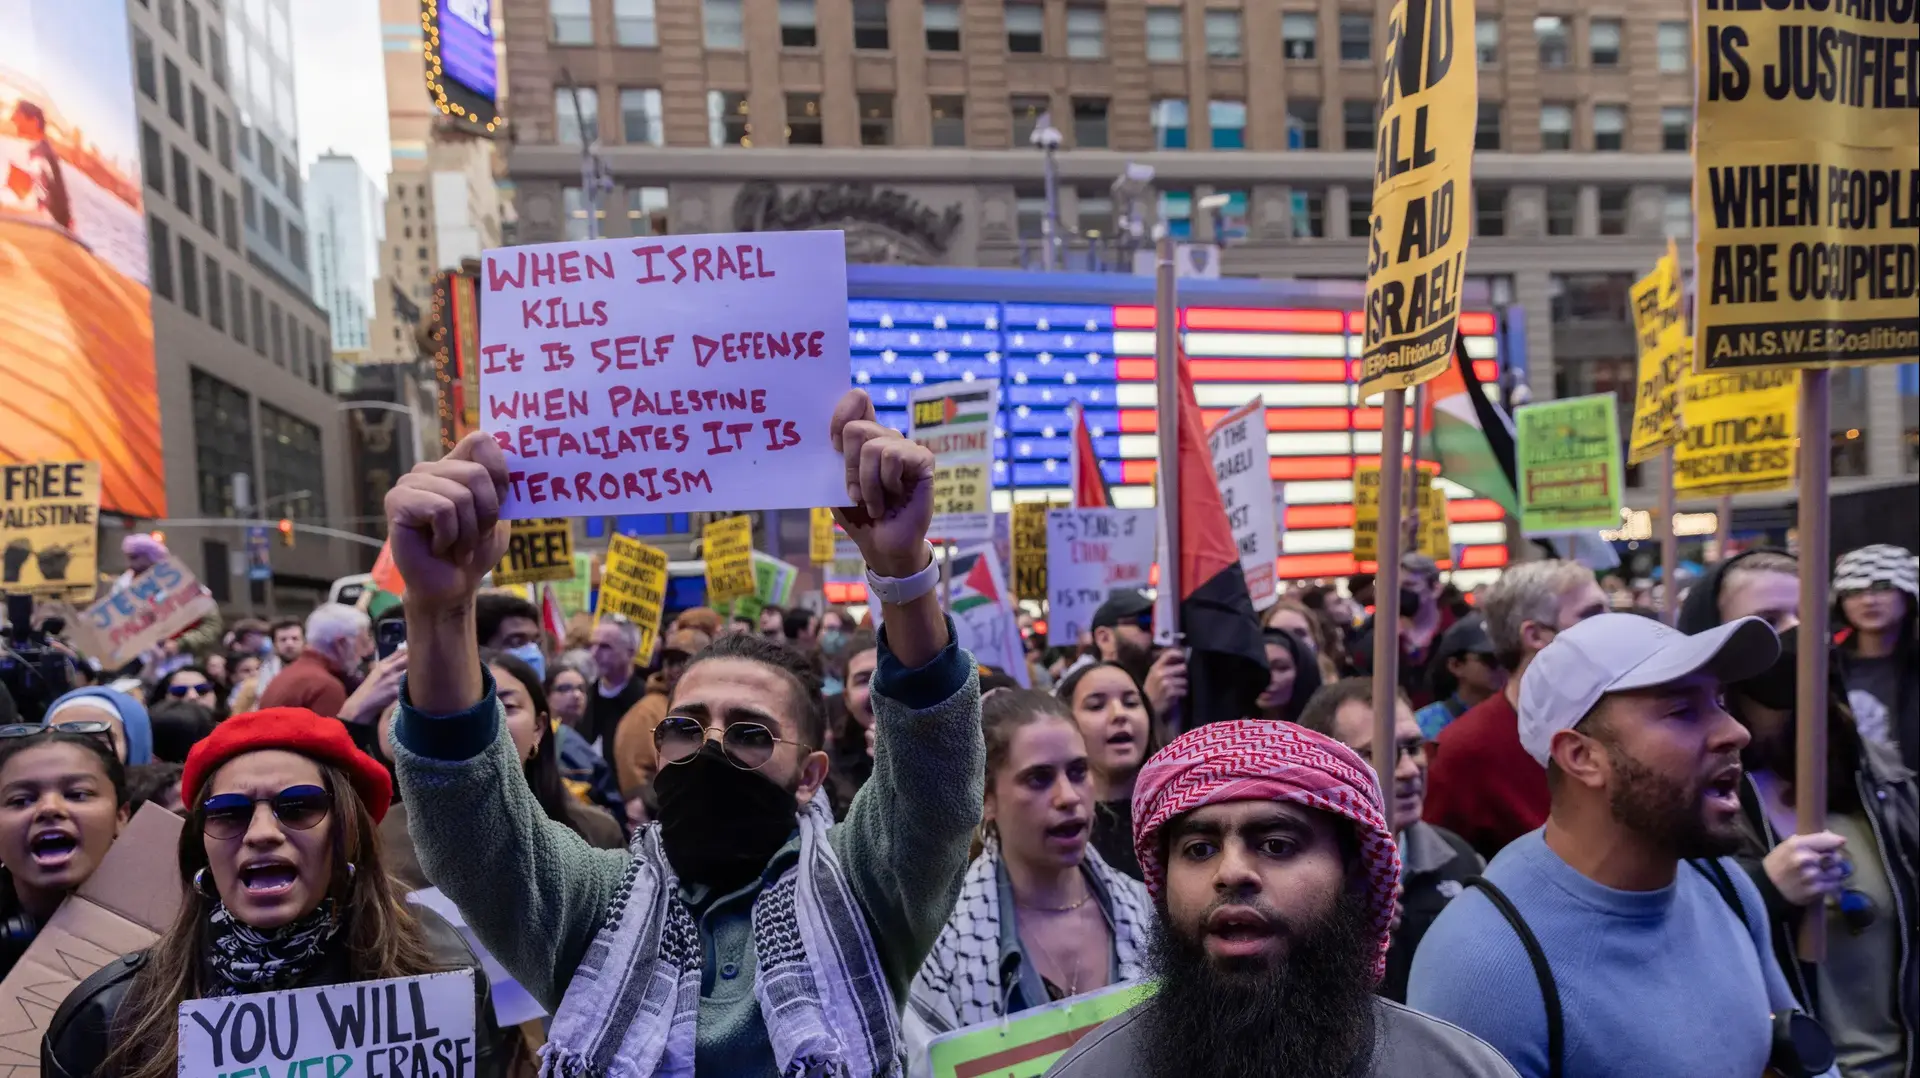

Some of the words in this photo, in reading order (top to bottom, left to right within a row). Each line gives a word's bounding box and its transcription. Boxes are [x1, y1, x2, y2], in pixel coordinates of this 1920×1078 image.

[1707, 25, 1750, 101] IS
[1376, 104, 1436, 184] ALL
[1708, 164, 1820, 229] WHEN
[1397, 179, 1454, 264] AID
[487, 251, 615, 292] WHEN
[632, 244, 775, 285] ISRAEL
[1711, 243, 1778, 305] ARE
[1789, 242, 1919, 301] OCUPIED
[522, 297, 608, 329] KILLS
[1365, 250, 1462, 347] ISRAEL!
[590, 334, 675, 373] SELF
[692, 331, 825, 368] DEFENSE
[489, 388, 589, 421] WHEN
[608, 385, 766, 418] PALESTINE
[492, 424, 689, 459] RETALIATES
[703, 421, 753, 455] IT
[762, 418, 801, 452] IS
[1682, 413, 1792, 451] OLITICAL
[5, 463, 84, 500] FREE
[508, 467, 713, 504] TERRORISM
[0, 504, 93, 530] ALESTINE
[508, 530, 569, 570] REE!
[92, 562, 184, 628] JEWS
[191, 994, 299, 1066] YOU
[317, 982, 439, 1050] WILL
